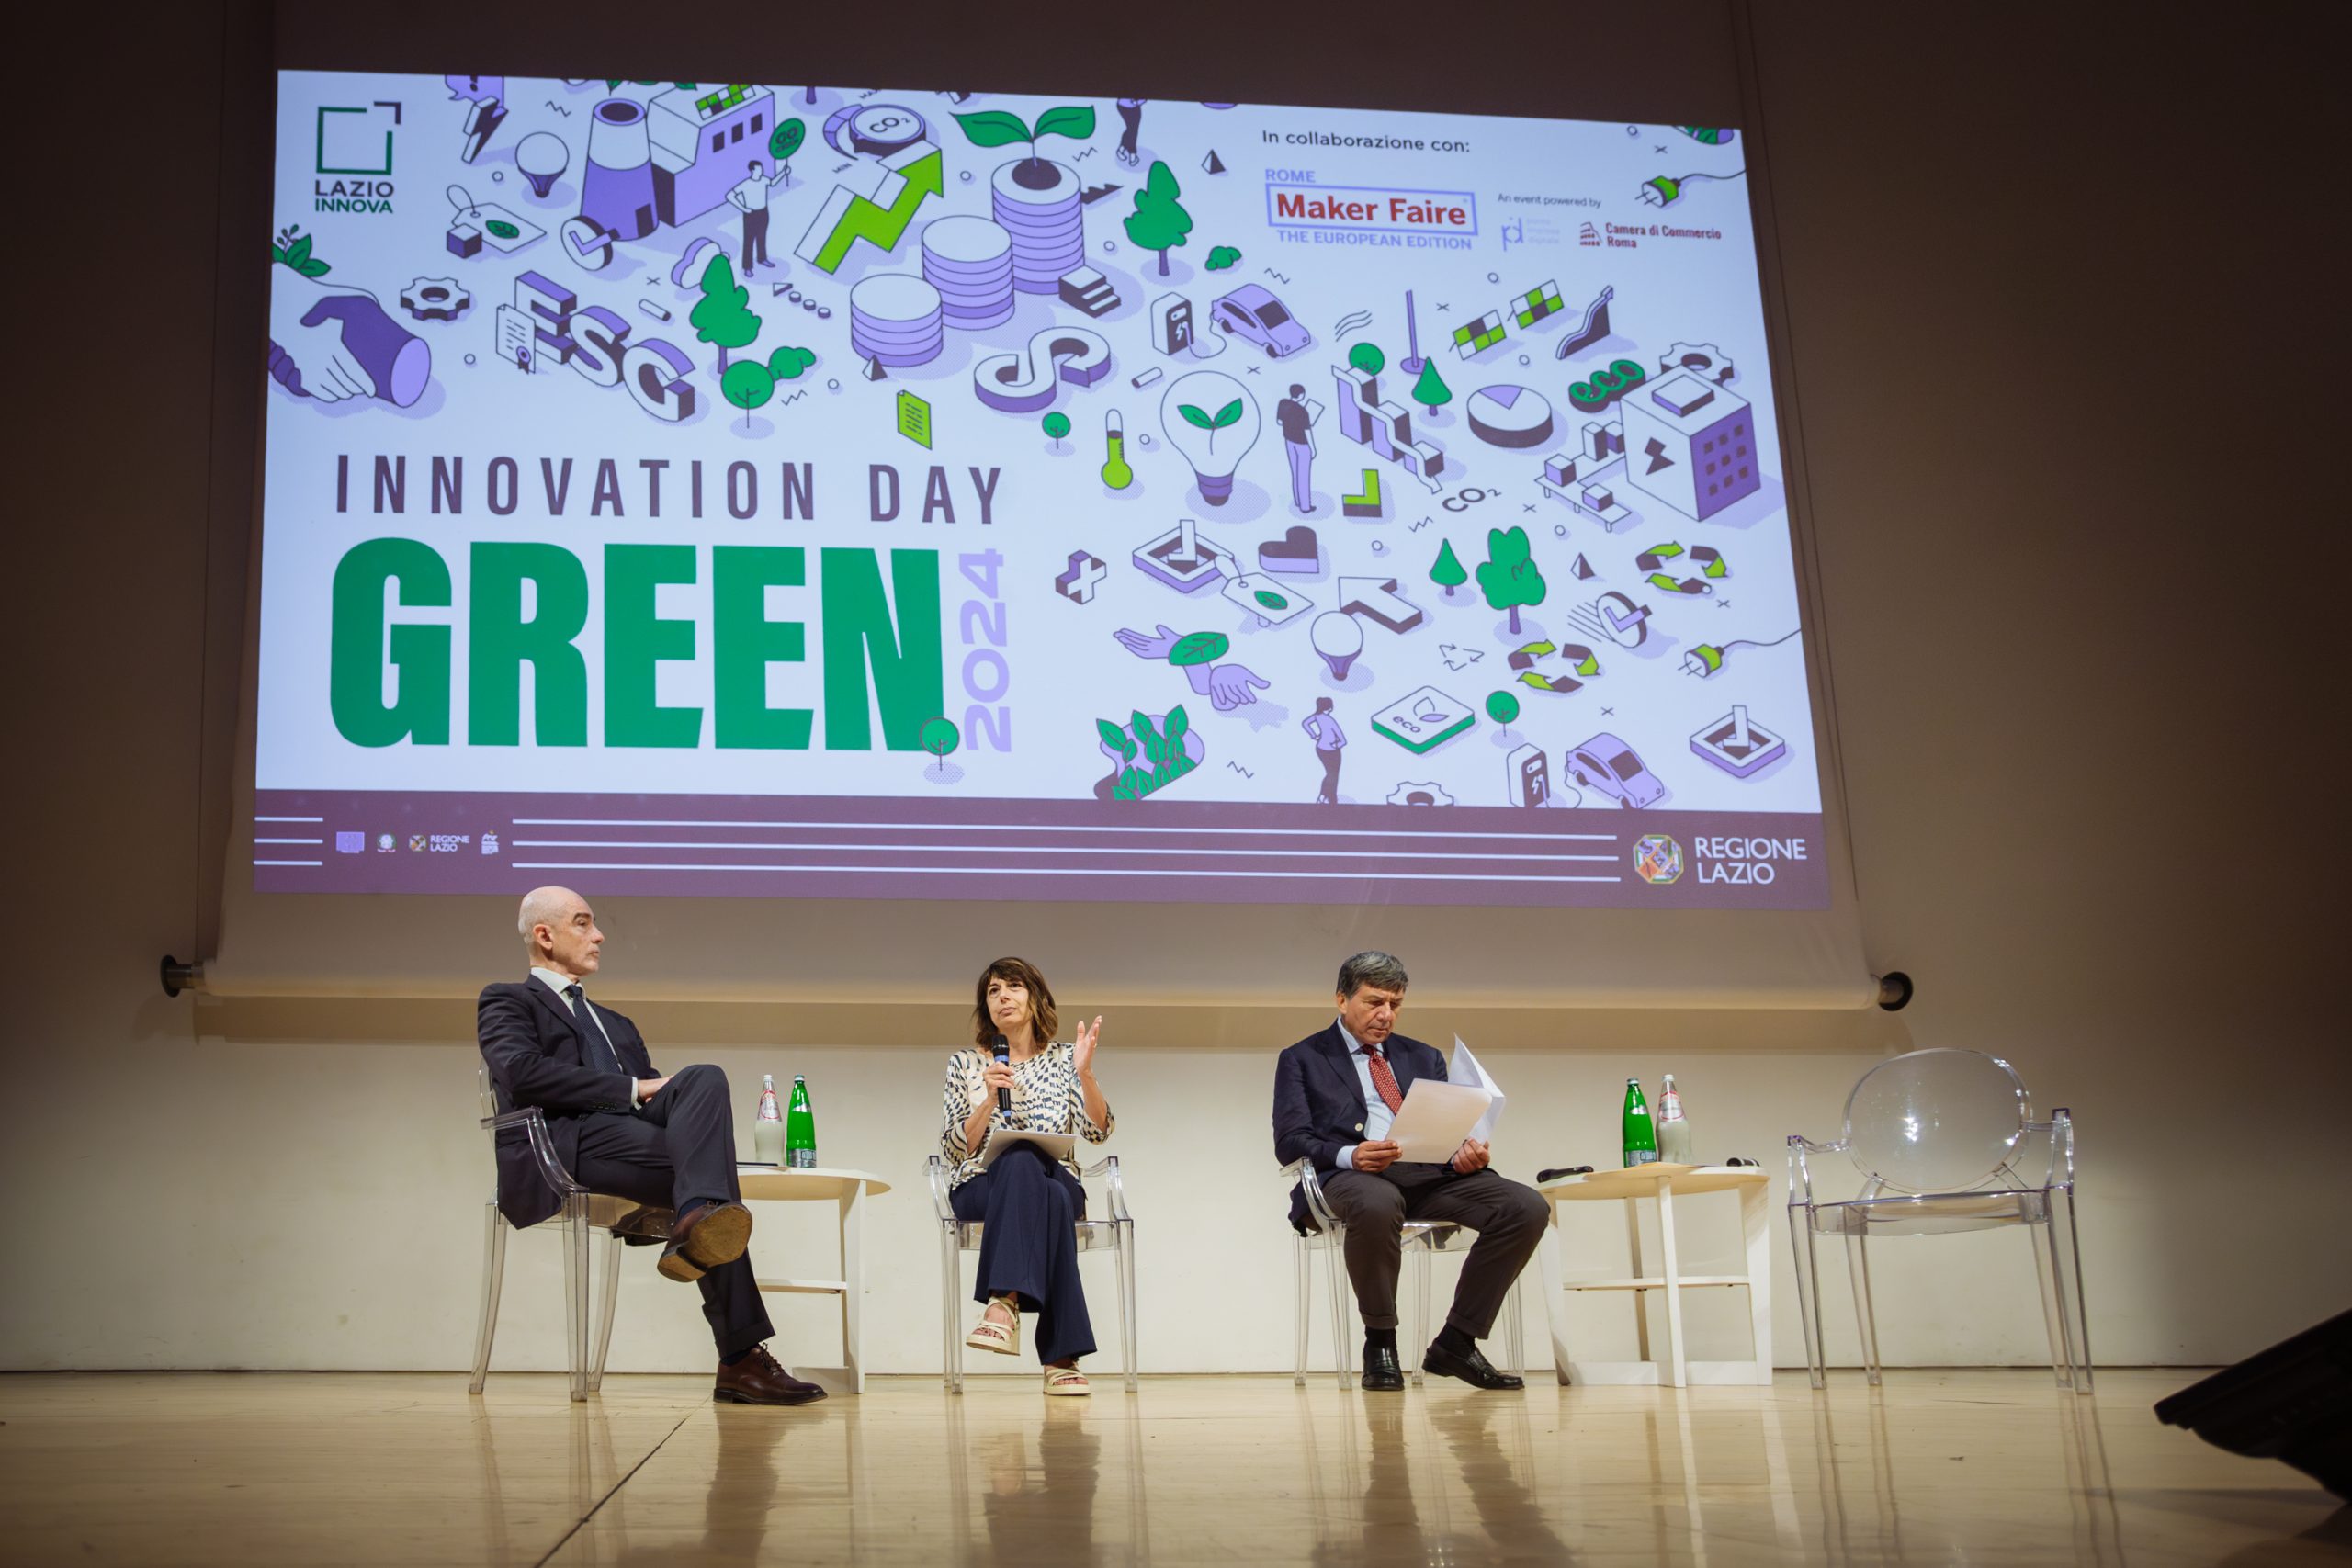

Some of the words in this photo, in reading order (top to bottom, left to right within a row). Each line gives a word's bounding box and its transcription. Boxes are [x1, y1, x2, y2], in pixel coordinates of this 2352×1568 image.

[1262, 130, 1279, 143] In
[1286, 131, 1425, 151] collaborazione
[1431, 139, 1470, 152] con:
[832, 163, 853, 175] MIN
[1265, 169, 1316, 183] ROME
[315, 179, 394, 197] LAZIO
[315, 197, 393, 213] INNOVA
[1277, 193, 1378, 220] Maker
[1389, 197, 1466, 225] Faire
[1498, 193, 1512, 203] An
[1513, 195, 1542, 205] event
[1544, 197, 1588, 208] powered
[1589, 198, 1601, 209] by
[1277, 230, 1309, 243] THE
[1314, 231, 1402, 247] EUROPEAN
[1407, 235, 1472, 250] EDITION
[1605, 222, 1646, 236] Camera
[1649, 224, 1659, 236] di
[1661, 225, 1722, 240] Commercio
[1607, 236, 1637, 248] Roma
[336, 455, 813, 520] INNOVATION
[869, 464, 1001, 525] DAY
[331, 537, 944, 751] GREEN
[958, 548, 1012, 752] 2024
[1393, 716, 1421, 733] eco
[430, 835, 470, 844] REGIONE
[430, 843, 458, 852] LAZIO
[1694, 837, 1807, 860] REGIONE
[1697, 862, 1775, 885] LAZIO
